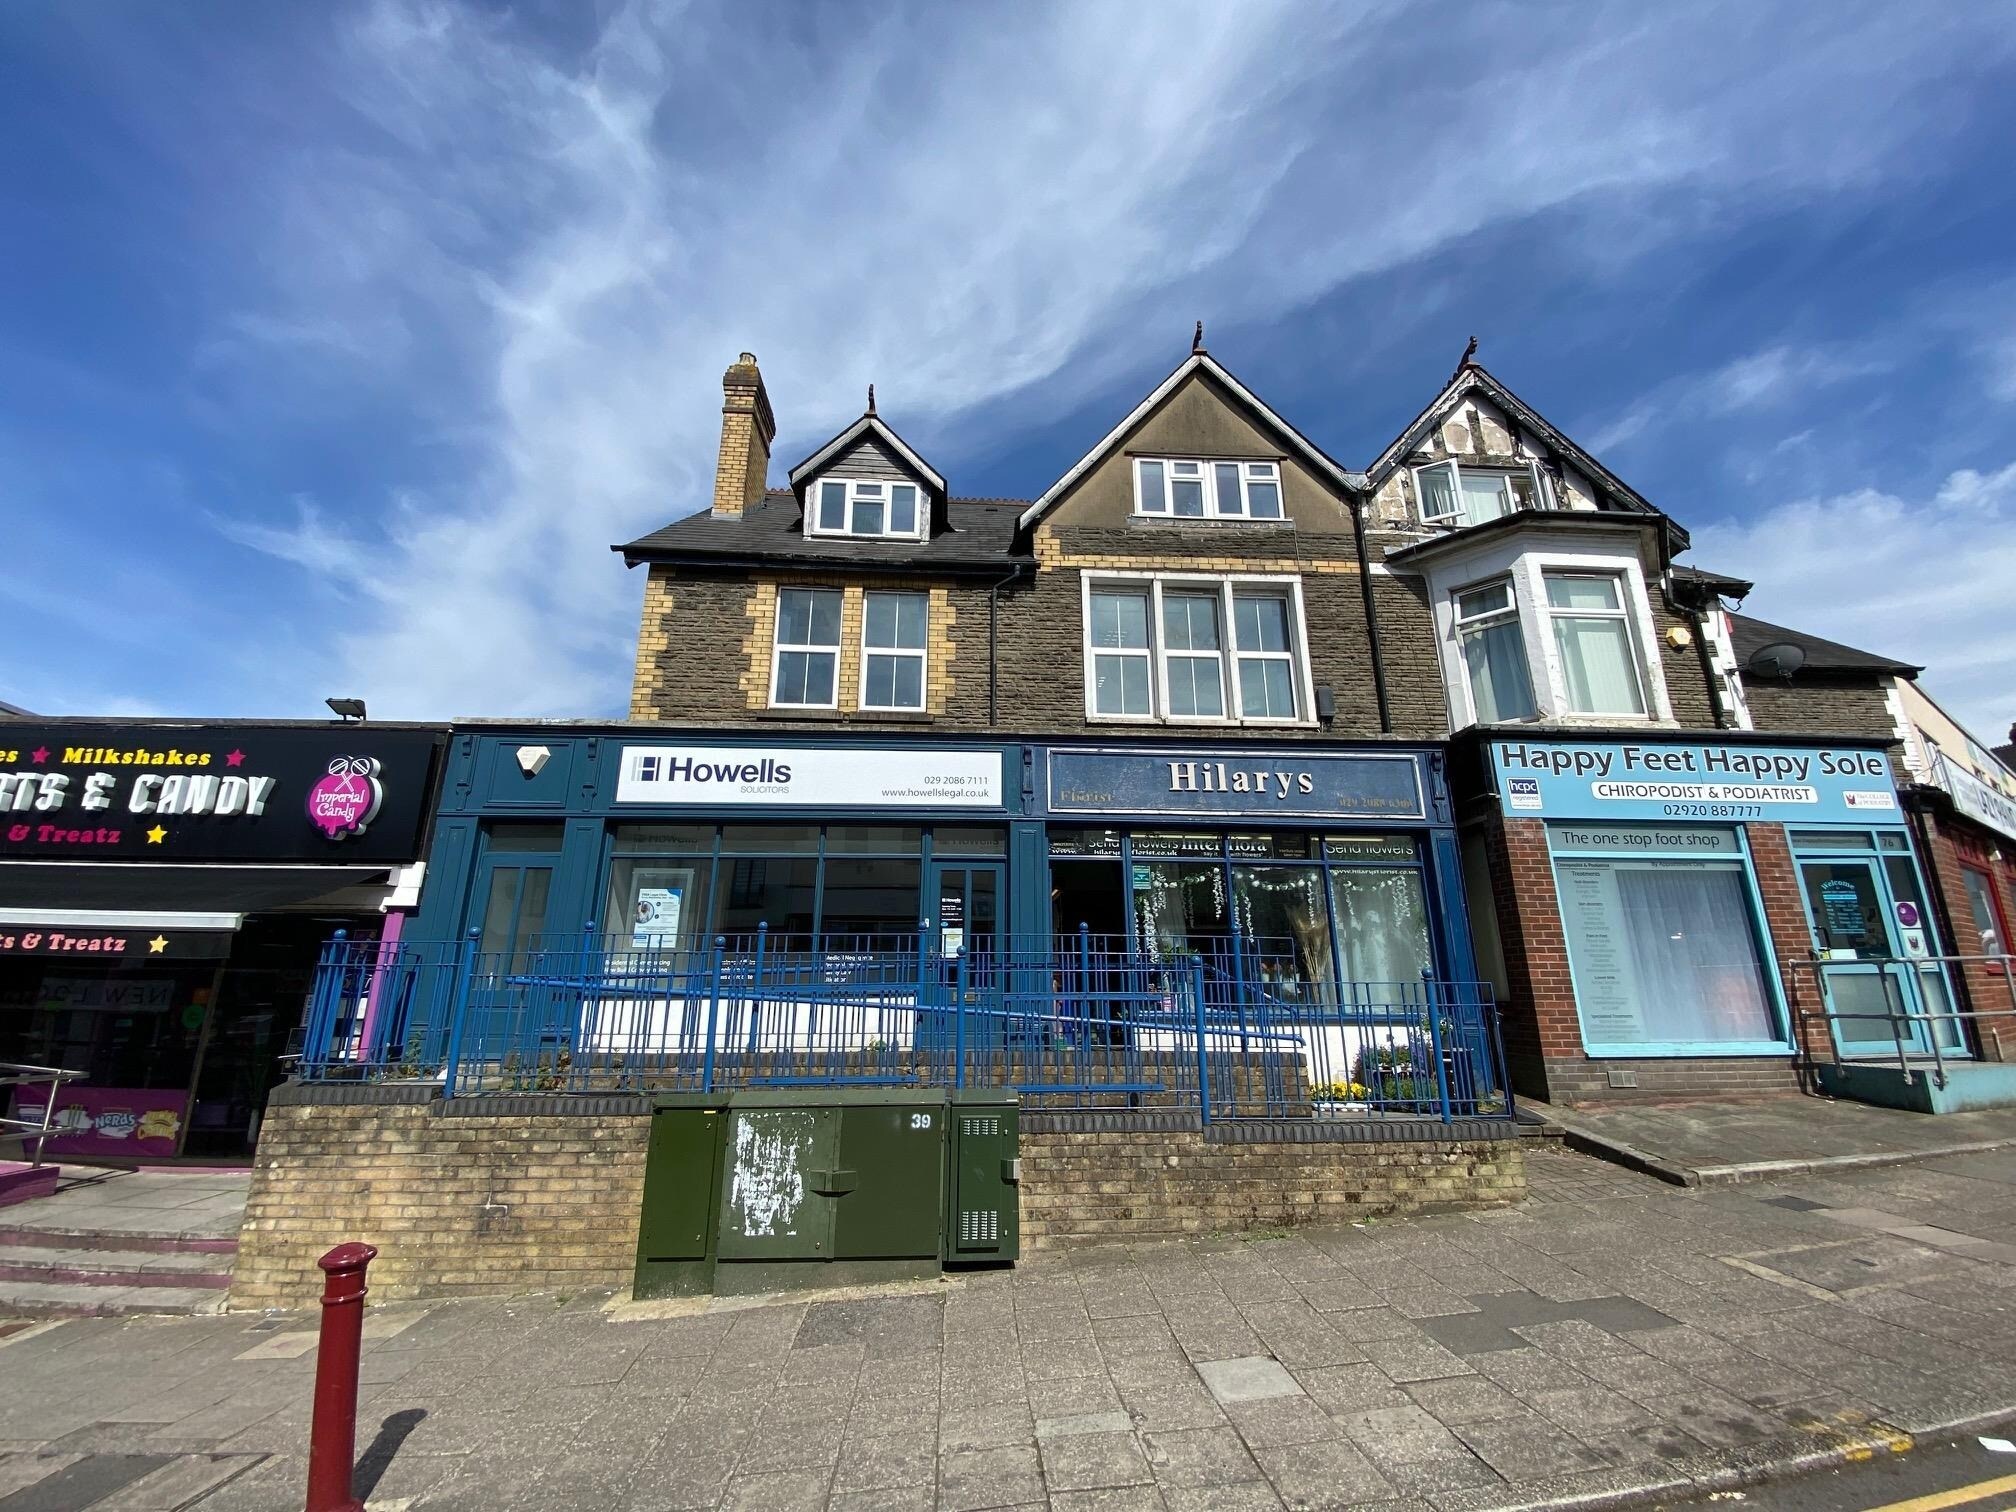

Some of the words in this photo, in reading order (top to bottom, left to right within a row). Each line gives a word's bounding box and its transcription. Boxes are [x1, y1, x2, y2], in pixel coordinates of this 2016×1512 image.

[61, 747, 212, 766] Milkshakes
[1501, 743, 1613, 777] Happy
[1622, 746, 1697, 772] Feet
[1703, 748, 1810, 781] Happy
[1818, 751, 1883, 776] Sole
[668, 756, 792, 784] Howells
[924, 775, 941, 785] 029
[943, 776, 965, 785] 2086
[967, 776, 989, 785] 7111
[1167, 762, 1314, 799] Hilarys
[1509, 779, 1537, 794] hcpc
[0, 771, 70, 812] TS
[81, 771, 116, 811] &
[128, 773, 277, 816] CANDY
[315, 788, 366, 806] Imperial
[740, 785, 790, 794] SOLICITORS
[881, 788, 989, 799] www.howellslegal.co.uk
[1598, 784, 1702, 798] CHIROPODIST
[1708, 788, 1720, 799] &
[1723, 786, 1811, 800] PODIATRIST
[316, 802, 355, 823] Candy
[1663, 804, 1708, 817] 02920
[1711, 804, 1761, 817] 887777
[8, 825, 30, 842] &
[37, 825, 121, 844] Treatz
[1562, 831, 1589, 844] The
[1592, 835, 1619, 845] one
[1623, 834, 1652, 848] stop
[1655, 832, 1684, 846] foot
[1686, 833, 1720, 848] shop
[1881, 838, 1894, 848] 76
[21, 932, 42, 949] &
[49, 934, 127, 952] Treatz
[911, 1113, 931, 1129] 39
